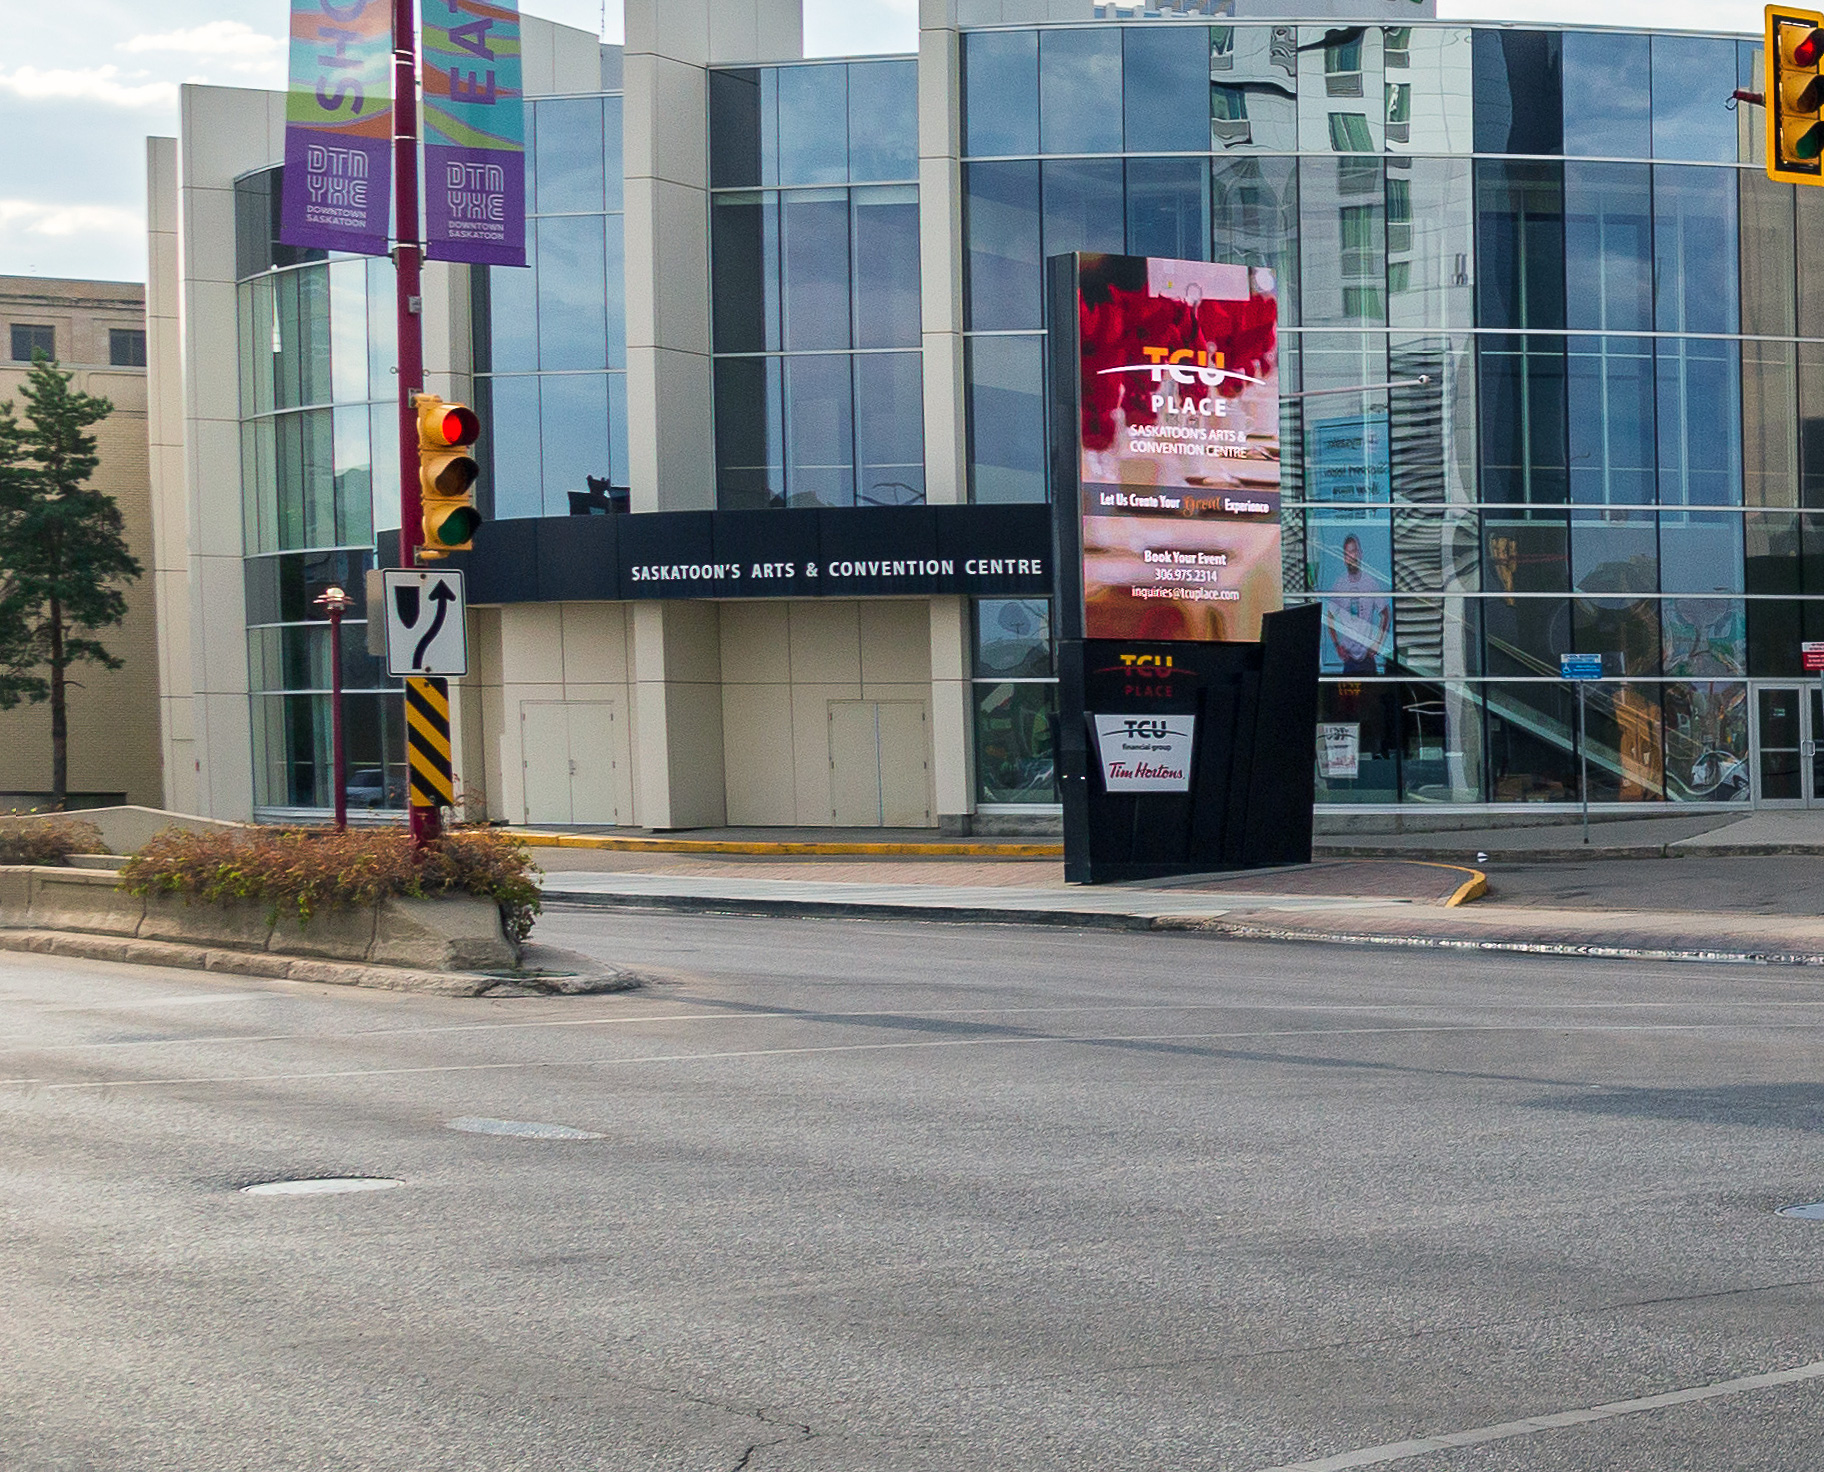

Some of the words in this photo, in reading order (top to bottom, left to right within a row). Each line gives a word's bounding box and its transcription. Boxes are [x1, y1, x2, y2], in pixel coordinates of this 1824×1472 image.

[306, 205, 366, 218] DOWNTOWN
[306, 214, 366, 227] SASKATOON
[448, 220, 504, 231] DOWNTOWN
[448, 230, 504, 239] SASKATOON
[1143, 346, 1225, 386] TCU
[1151, 395, 1227, 417] PLACE
[1129, 424, 1207, 441] SASKATOON'S
[1208, 429, 1236, 442] ARTS
[1237, 431, 1246, 442] &
[1130, 440, 1204, 456] CONVENTION
[1206, 444, 1247, 459] CENTRE
[1100, 492, 1115, 506] Let
[1116, 493, 1128, 506] Us
[1129, 494, 1158, 508] Create
[1159, 495, 1180, 509] Your
[1224, 498, 1270, 514] Experience
[1144, 550, 1172, 563] Book
[1173, 551, 1197, 564] Your
[1198, 552, 1227, 566] Event
[632, 564, 741, 581] SASKATOON'S
[751, 563, 795, 578] ARTS
[806, 562, 818, 577] &
[829, 560, 954, 576] CONVENTION
[965, 559, 1042, 575] CENTRE
[1131, 585, 1240, 601] inquiries@tcuplace.com
[1120, 654, 1172, 678] TCU
[1125, 685, 1172, 697] PLACE
[1124, 720, 1166, 739] TCU
[1151, 744, 1172, 752] group
[1109, 761, 1133, 779] Tim
[1134, 761, 1184, 779] Hortons
